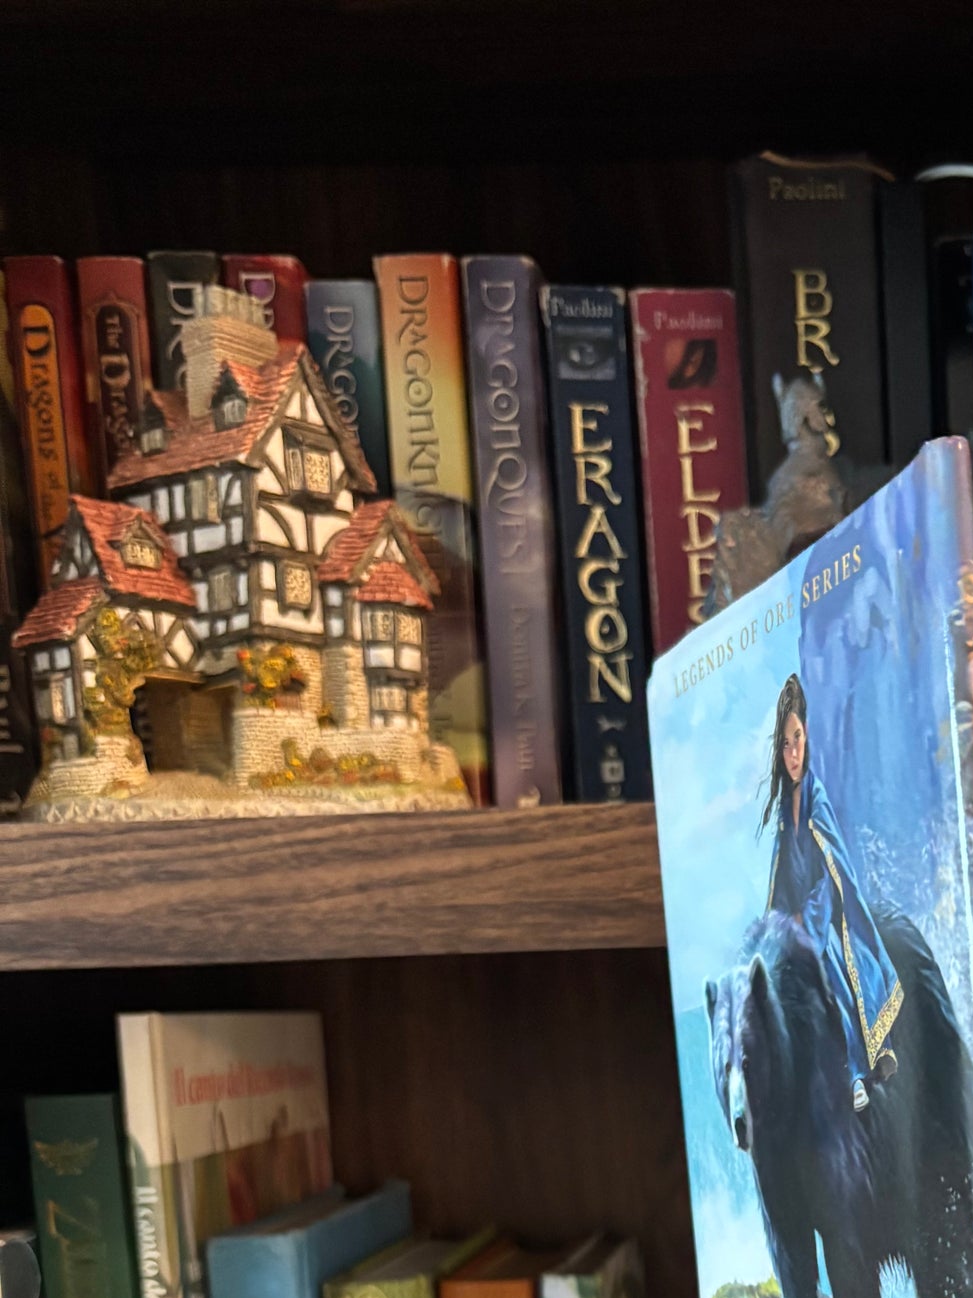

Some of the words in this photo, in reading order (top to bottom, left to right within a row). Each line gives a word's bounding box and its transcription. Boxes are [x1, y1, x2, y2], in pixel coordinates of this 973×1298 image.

[568, 402, 632, 702] ERAGON
[673, 635, 735, 699] LEGENDS
[740, 618, 758, 652] OF
[764, 592, 795, 635] ORE
[802, 543, 862, 609] SERIES
